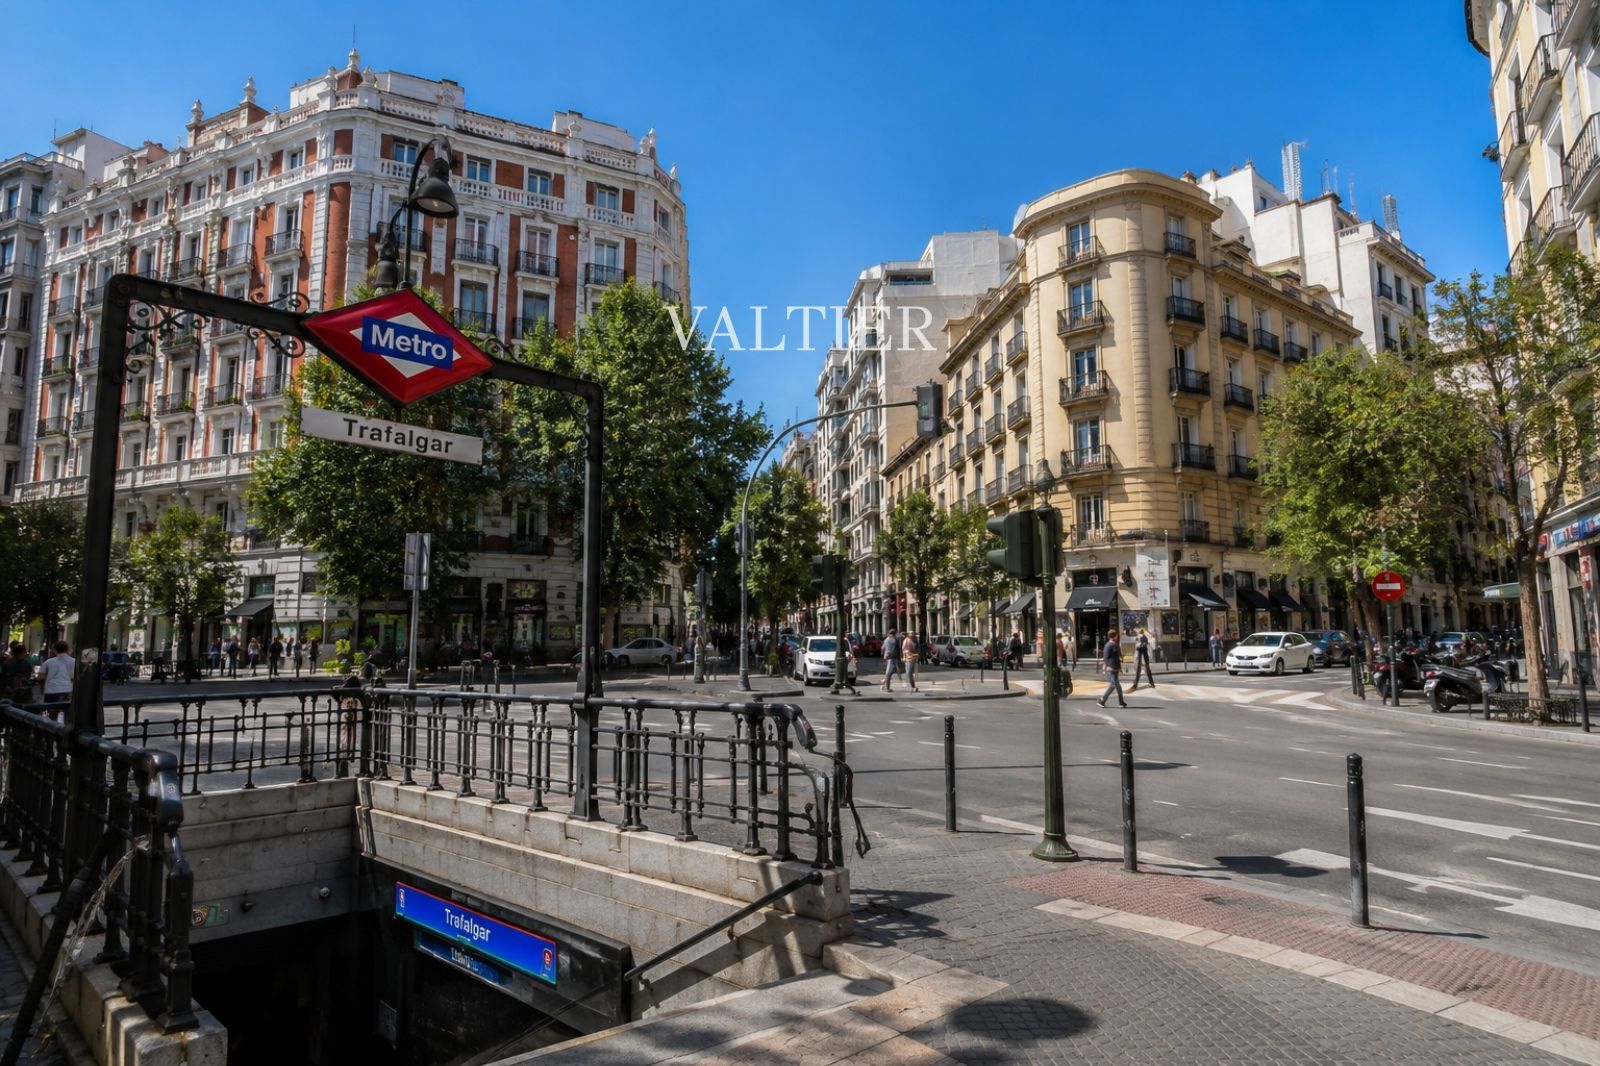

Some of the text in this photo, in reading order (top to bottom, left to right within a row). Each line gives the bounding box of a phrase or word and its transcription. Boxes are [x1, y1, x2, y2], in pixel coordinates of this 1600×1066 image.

[371, 323, 447, 360] Metro
[343, 418, 453, 453] Trafalgar
[444, 908, 491, 942] Trafalgar
